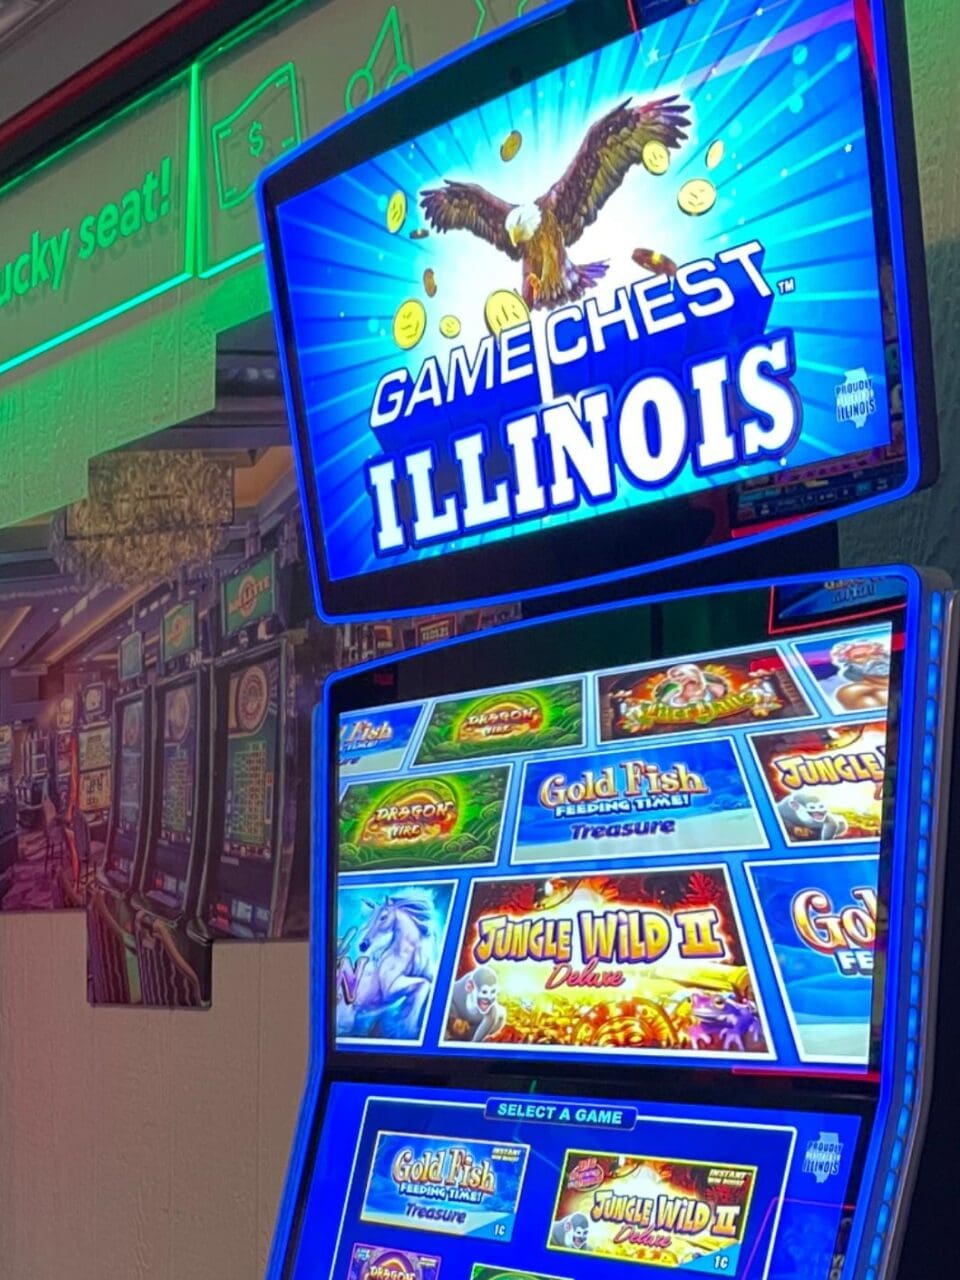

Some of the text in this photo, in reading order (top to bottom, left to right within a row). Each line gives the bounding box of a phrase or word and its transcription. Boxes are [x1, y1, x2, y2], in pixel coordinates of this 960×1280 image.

[77, 156, 172, 261] seat!
[837, 399, 876, 421] ILLINOIS
[367, 335, 802, 556] ILLINOIS
[467, 705, 538, 728] DRAGON
[773, 751, 886, 790] JUNGLE
[540, 760, 709, 810] Gold Fish
[376, 800, 456, 823] DRAGON
[555, 793, 691, 820] FEEDING TIME!
[570, 818, 676, 842] Treasure
[474, 915, 574, 966] JUNGLE
[673, 908, 727, 960] II
[544, 957, 626, 990] Deluxe
[497, 1102, 624, 1126] SELECT A GAME
[392, 1147, 497, 1195] Gold Fish
[398, 1183, 484, 1205] FEEDING TIME!
[405, 1202, 468, 1226] Treasure
[591, 1189, 655, 1228] JUNGLE
[710, 1205, 741, 1237] II
[613, 1224, 673, 1249] Deluxe
